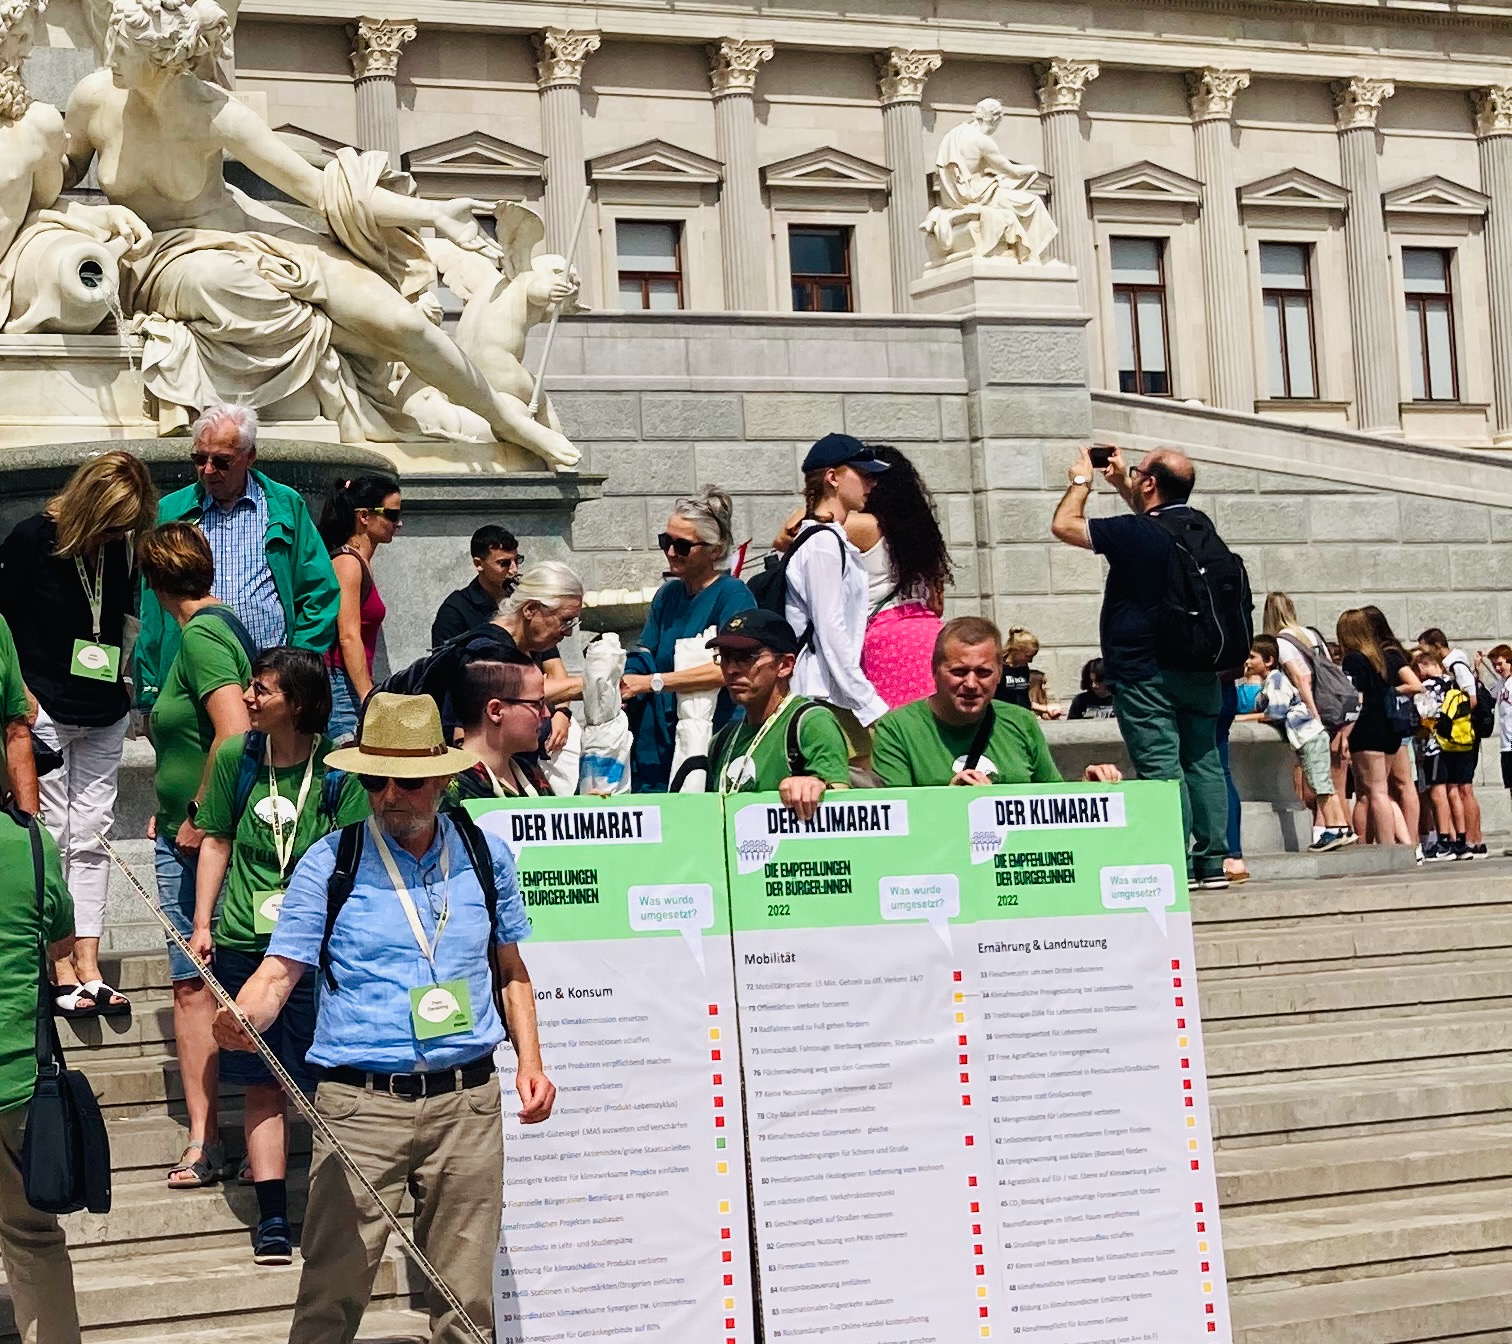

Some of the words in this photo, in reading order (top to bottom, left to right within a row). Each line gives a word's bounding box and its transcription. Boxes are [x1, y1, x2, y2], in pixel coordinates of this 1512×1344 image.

[995, 799, 1025, 825] DER
[1029, 797, 1108, 824] KLIMARAT
[511, 813, 547, 841] DER
[551, 811, 642, 840] KLIMARAT
[767, 807, 800, 834] DER
[993, 853, 1007, 868] DIE
[1008, 851, 1073, 868] EMPFEHLUNGEN
[764, 862, 778, 878] DIE
[780, 860, 851, 877] EMPFEHLUNGEN
[522, 869, 597, 887] EMPFEHLUNGEN
[995, 871, 1012, 886] DER
[1013, 868, 1075, 885] BÜRGER:INNEN
[1109, 875, 1129, 885] Was
[1130, 874, 1158, 884] wurde
[765, 880, 783, 896] DER
[785, 878, 852, 895] BÜRGER:INNEN
[889, 886, 910, 895] Was
[912, 884, 941, 894] wurde
[1111, 887, 1161, 900] umgesetzt?
[527, 888, 598, 906] BÜRGER:INNEN
[638, 895, 660, 905] Was
[663, 894, 694, 904] wurde
[996, 894, 1018, 906] 2022
[767, 904, 790, 916] 2022
[890, 898, 944, 911] umgesetzt?
[640, 908, 697, 922] umgesetzt?
[978, 941, 1031, 953] Ernährung
[1032, 939, 1041, 950] &
[1043, 938, 1107, 950] Landnutzung
[744, 952, 795, 964] Mobilität
[555, 987, 564, 999] &
[568, 987, 612, 998] Konsum
